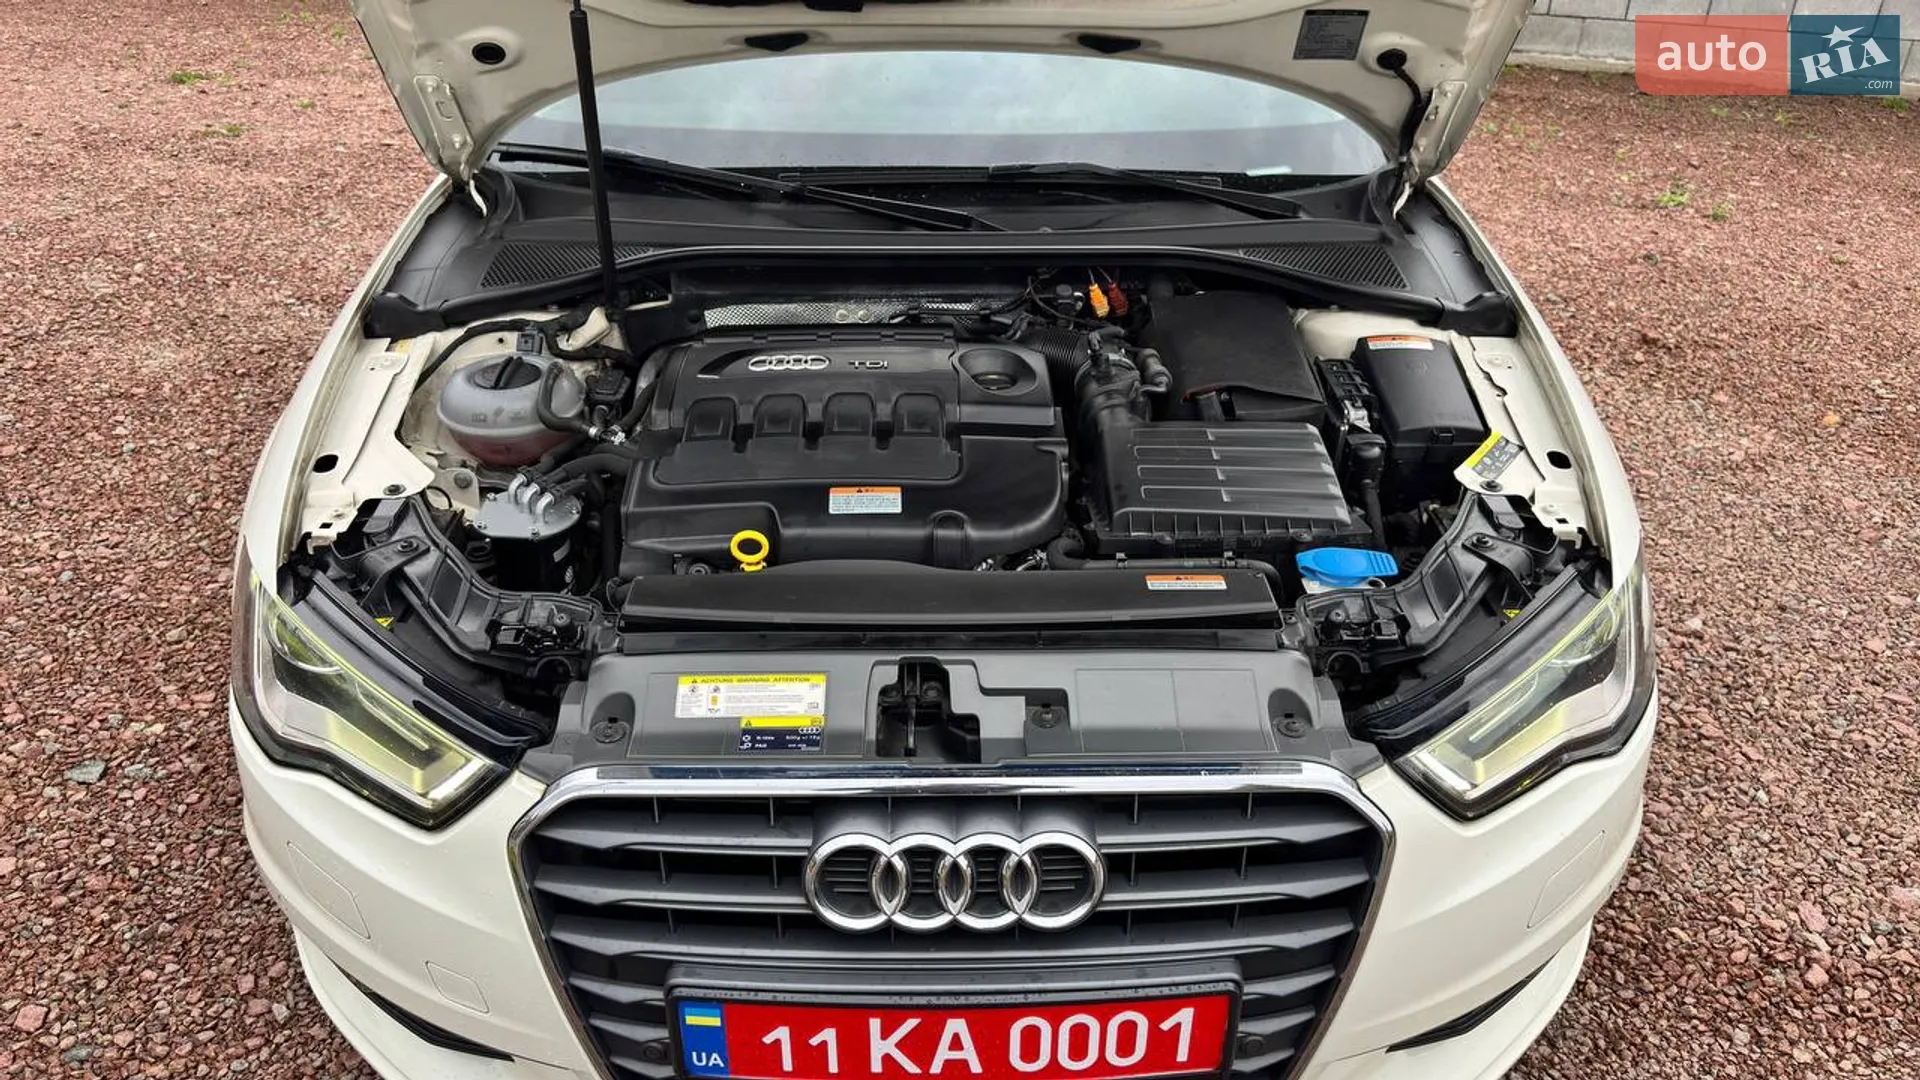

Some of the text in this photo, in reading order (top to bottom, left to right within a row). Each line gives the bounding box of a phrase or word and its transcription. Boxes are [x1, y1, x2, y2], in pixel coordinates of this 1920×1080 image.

[849, 360, 888, 369] TDI
[761, 1007, 1195, 1074] 11 KA 0001
[691, 1052, 725, 1067] UA
